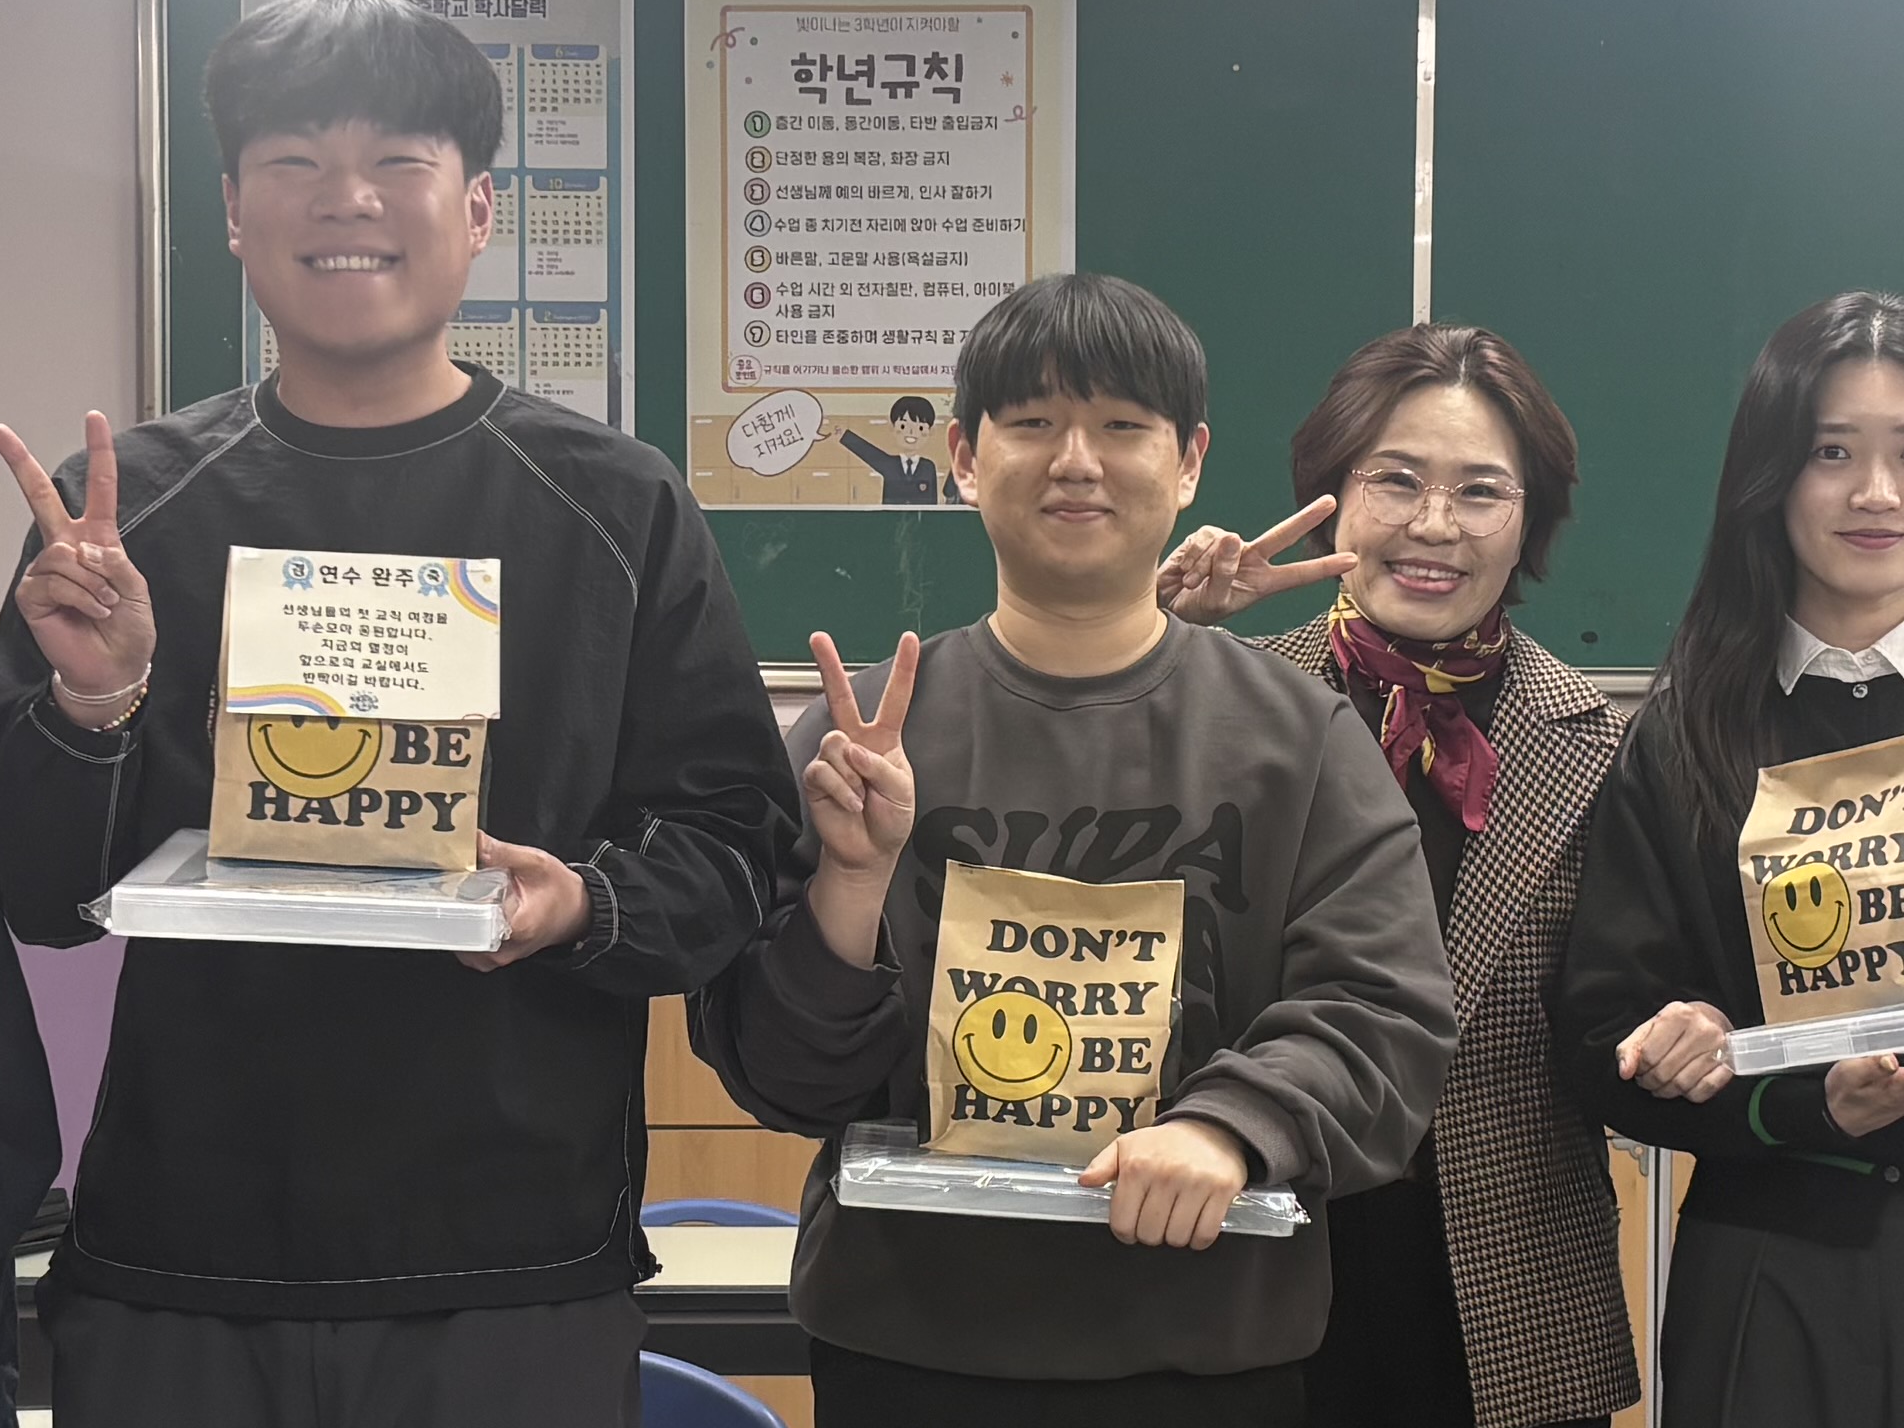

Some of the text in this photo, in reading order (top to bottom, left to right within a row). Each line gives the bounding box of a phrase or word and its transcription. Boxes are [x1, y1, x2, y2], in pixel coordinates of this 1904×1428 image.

[854, 17, 902, 33] 3학년이
[791, 51, 963, 106] 학년규칙
[776, 116, 802, 130] 층간
[910, 116, 937, 130] 타반
[942, 115, 997, 130] 출입금지
[776, 151, 817, 166] 단정한
[822, 151, 848, 166] 용의
[891, 151, 919, 166] 화장
[923, 151, 949, 166] 금지
[776, 185, 832, 200] 선생님께
[836, 185, 863, 199] 예의
[868, 185, 913, 200] 바르게,
[920, 185, 946, 200] 인사
[951, 185, 992, 200] 잘하기
[774, 218, 800, 232] 수업
[805, 218, 817, 232] 종
[821, 218, 862, 232] 치기전
[866, 218, 906, 232] 자리에
[911, 218, 937, 232] 앉아
[942, 218, 967, 232] 수업
[972, 217, 1027, 235] 준비하기
[776, 251, 822, 267] 바른말,
[828, 252, 868, 266] 고운말
[776, 282, 802, 297] 수업
[808, 282, 835, 297] 시간
[840, 283, 852, 296] 외
[857, 282, 917, 297] 전자칠판,
[923, 282, 969, 297] 컴퓨터,
[776, 304, 834, 319] 사용 금지
[776, 330, 817, 344] 타인을
[823, 330, 877, 344] 존중하며
[882, 329, 937, 344] 생활규칙
[942, 330, 955, 344] 잘
[742, 404, 796, 438] 다함께
[754, 426, 804, 458] 지켜요!
[320, 566, 361, 585] 연수
[372, 568, 414, 588] 완주
[283, 604, 350, 618] 선생님들의
[362, 659, 429, 673] 교실에서도
[390, 723, 472, 768] BE
[246, 781, 467, 832] HAPPY
[986, 918, 1166, 962] DON'T
[1078, 1036, 1152, 1074] BE
[951, 1083, 1147, 1134] HAPPY
